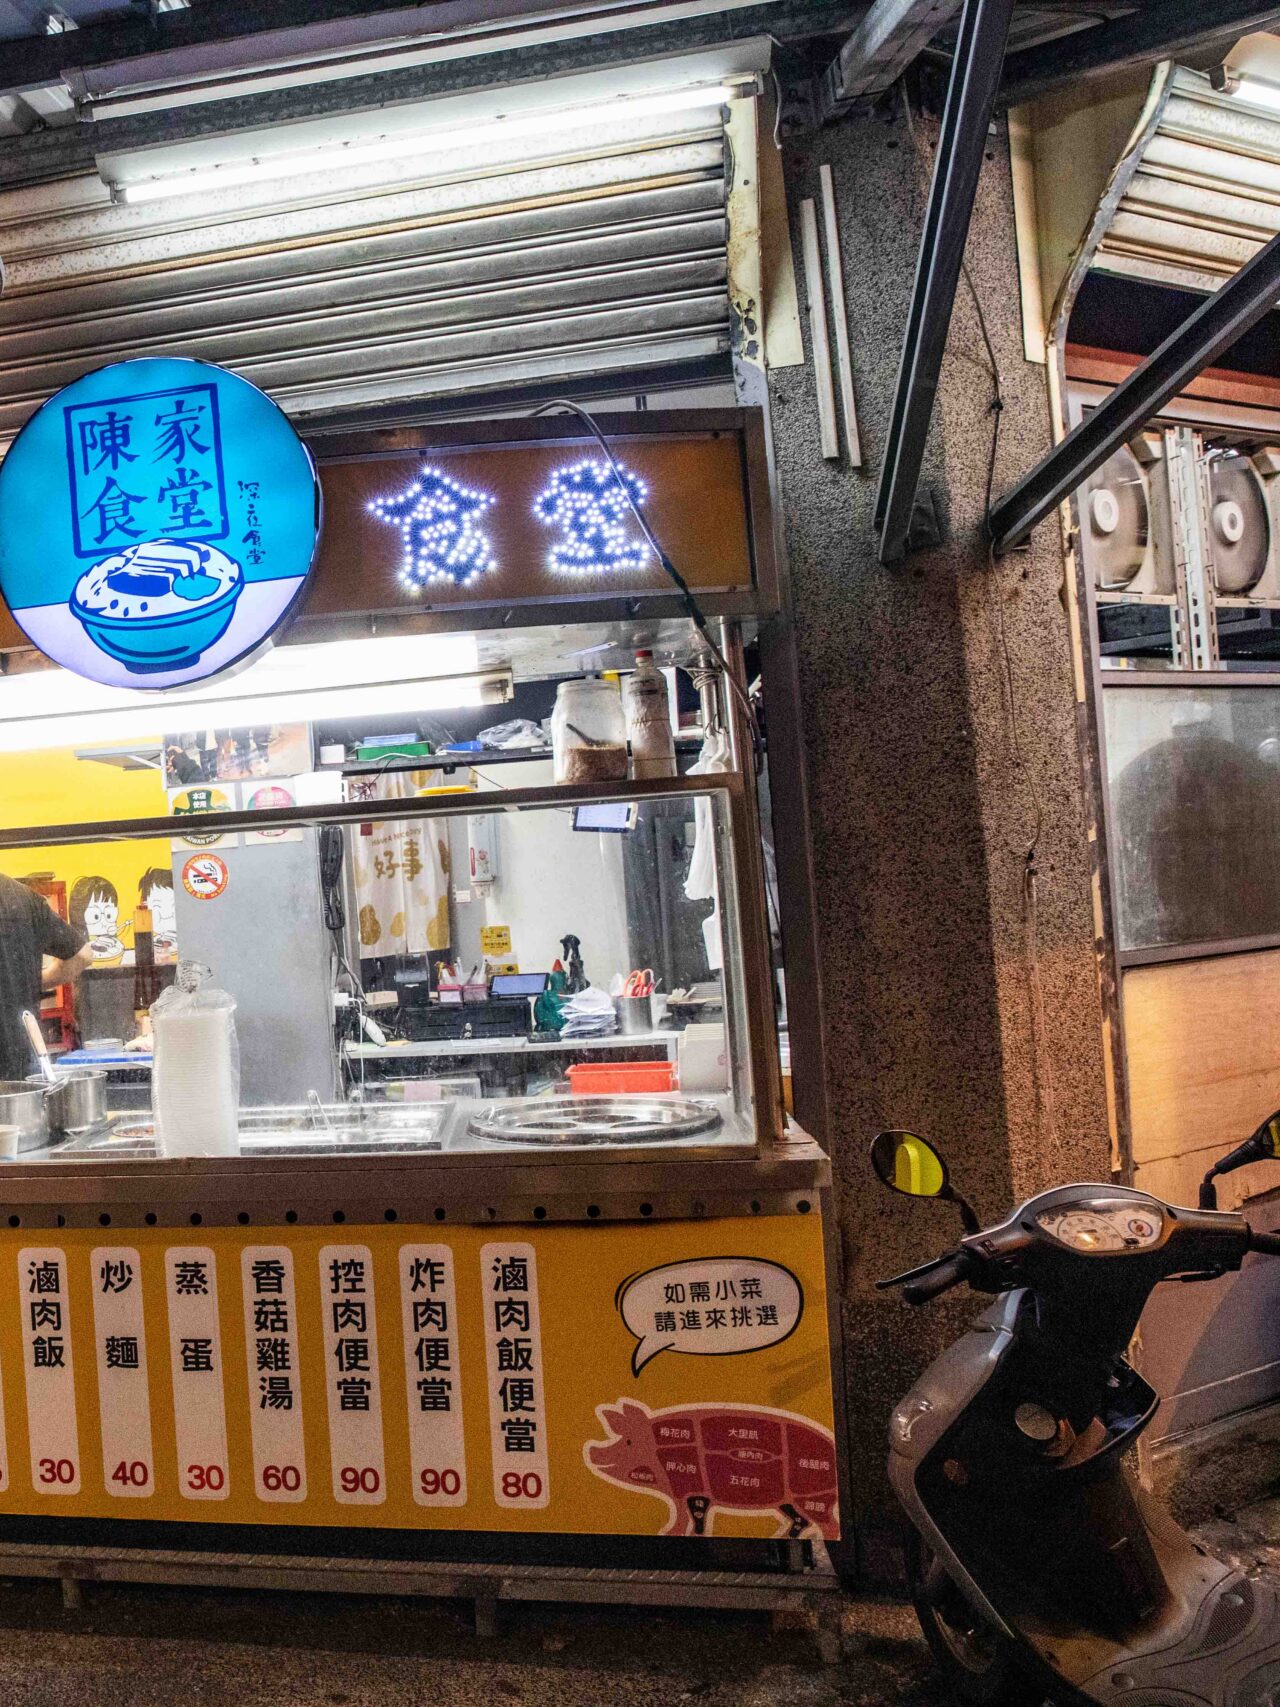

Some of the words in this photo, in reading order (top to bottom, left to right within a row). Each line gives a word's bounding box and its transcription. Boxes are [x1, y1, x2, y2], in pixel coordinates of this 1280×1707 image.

[81, 401, 212, 472] 陳家
[80, 467, 215, 546] 食堂
[237, 479, 267, 566] 深夜食堂
[367, 466, 649, 592] 食堂
[663, 1278, 763, 1304] 如需小菜
[27, 1261, 66, 1368] 滷肉飯
[100, 1261, 140, 1369] 炒麵
[174, 1262, 214, 1372] 蒸蛋
[654, 1305, 780, 1332] 請進來挑選
[251, 1260, 293, 1411] 香菇雞湯
[328, 1259, 372, 1412] 控肉便當
[409, 1258, 453, 1412] 炸肉便當
[491, 1257, 537, 1453] 滷肉飯便當
[660, 1427, 691, 1440] 梅花肉
[39, 1459, 75, 1484] 30
[111, 1461, 149, 1487] 40
[187, 1465, 224, 1490] 30
[263, 1465, 301, 1491] 60
[798, 1458, 830, 1471] 後腿肉
[340, 1467, 380, 1494] 90
[420, 1469, 461, 1496] 90
[501, 1472, 542, 1499] 80
[729, 1475, 760, 1488] 五花肉
